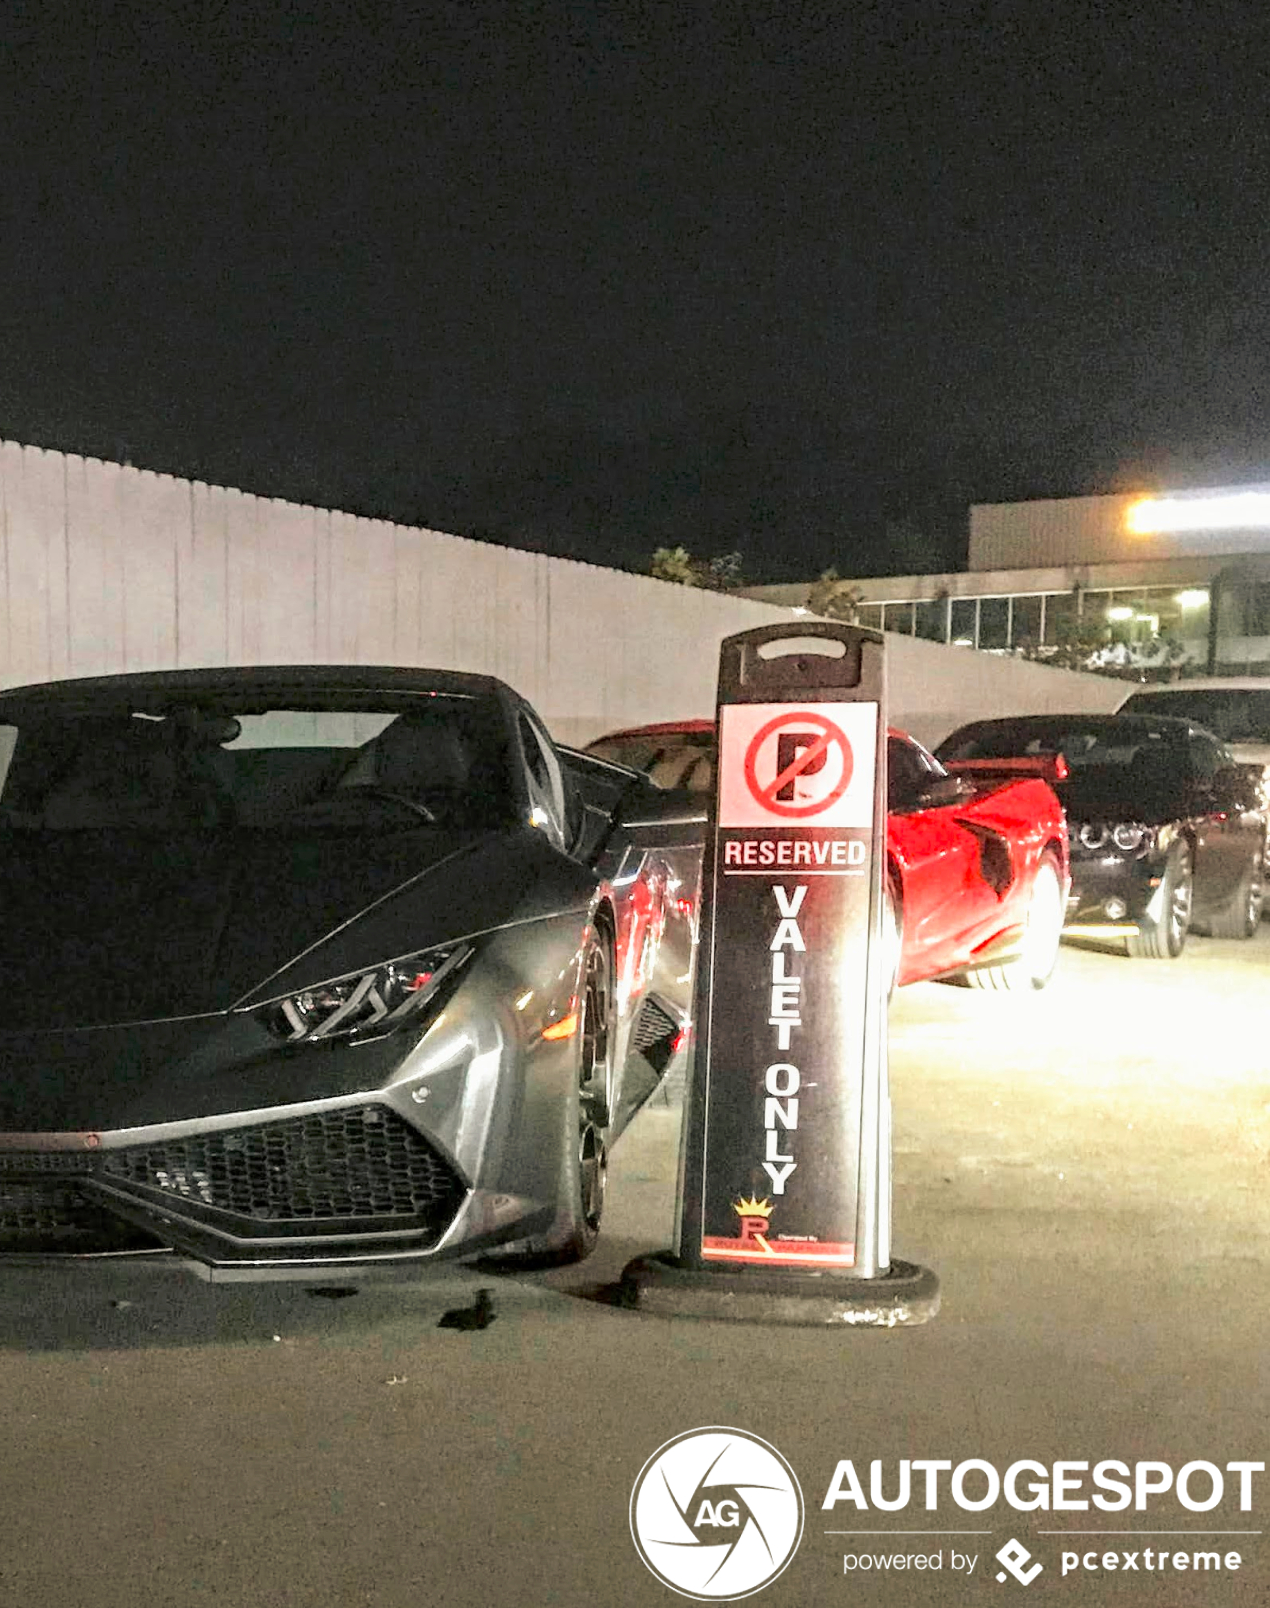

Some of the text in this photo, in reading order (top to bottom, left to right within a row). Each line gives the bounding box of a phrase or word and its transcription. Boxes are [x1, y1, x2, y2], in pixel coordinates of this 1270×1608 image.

[776, 733, 828, 801] P
[723, 840, 866, 866] RESERVED
[762, 885, 808, 1195] VALET ONLY
